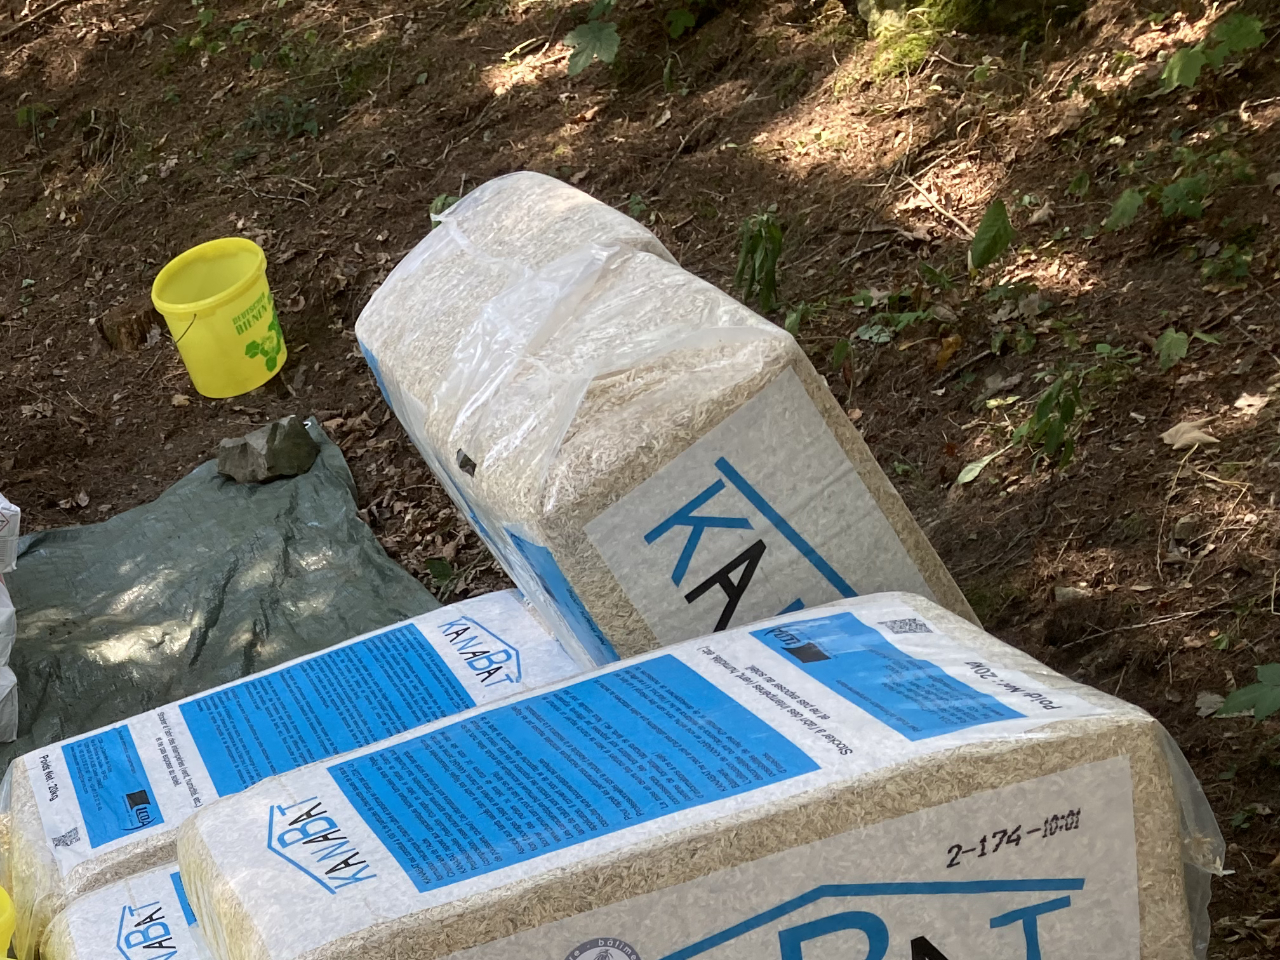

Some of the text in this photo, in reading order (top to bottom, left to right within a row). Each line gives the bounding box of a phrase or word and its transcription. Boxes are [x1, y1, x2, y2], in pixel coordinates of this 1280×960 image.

[437, 617, 520, 688] KANABAT
[39, 754, 61, 801] Poids Net 20kg
[278, 796, 377, 890] KANABAT
